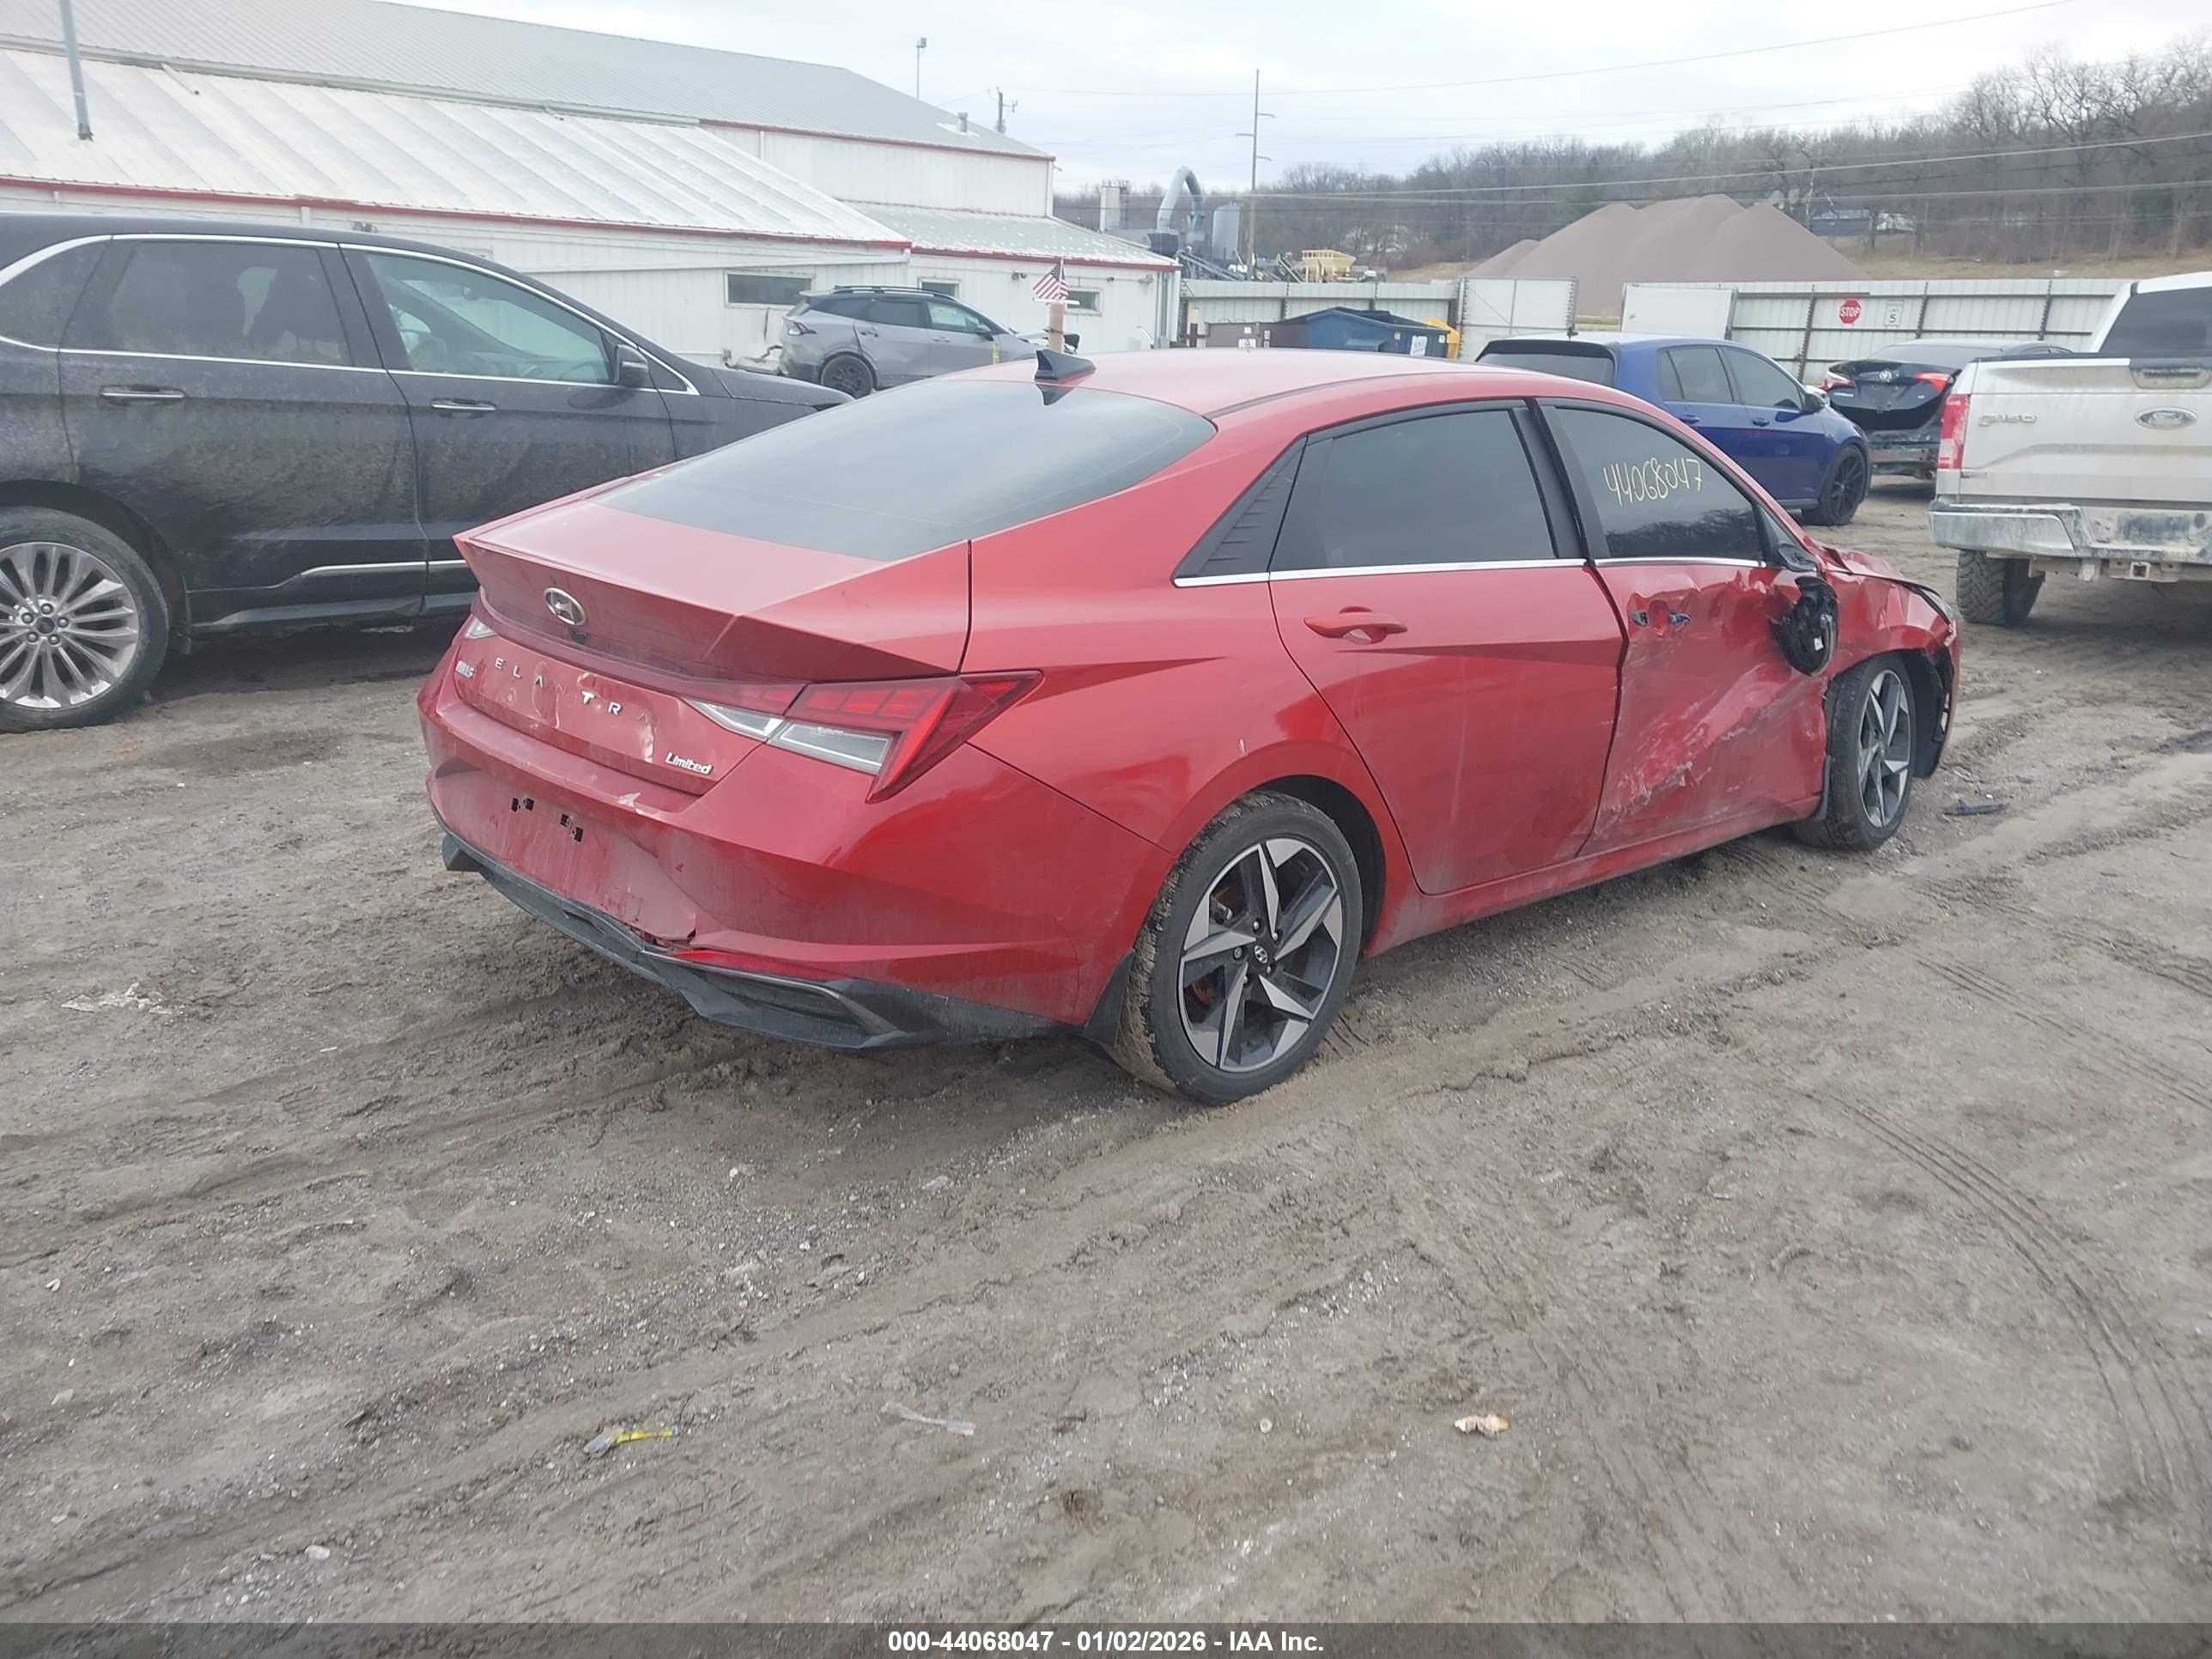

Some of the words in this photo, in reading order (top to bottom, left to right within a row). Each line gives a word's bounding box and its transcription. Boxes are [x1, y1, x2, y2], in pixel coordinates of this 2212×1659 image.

[1840, 307, 1862, 318] STOP
[1888, 313, 1897, 324] 5
[1603, 457, 1703, 507] 44068047
[665, 751, 713, 775] Limited
